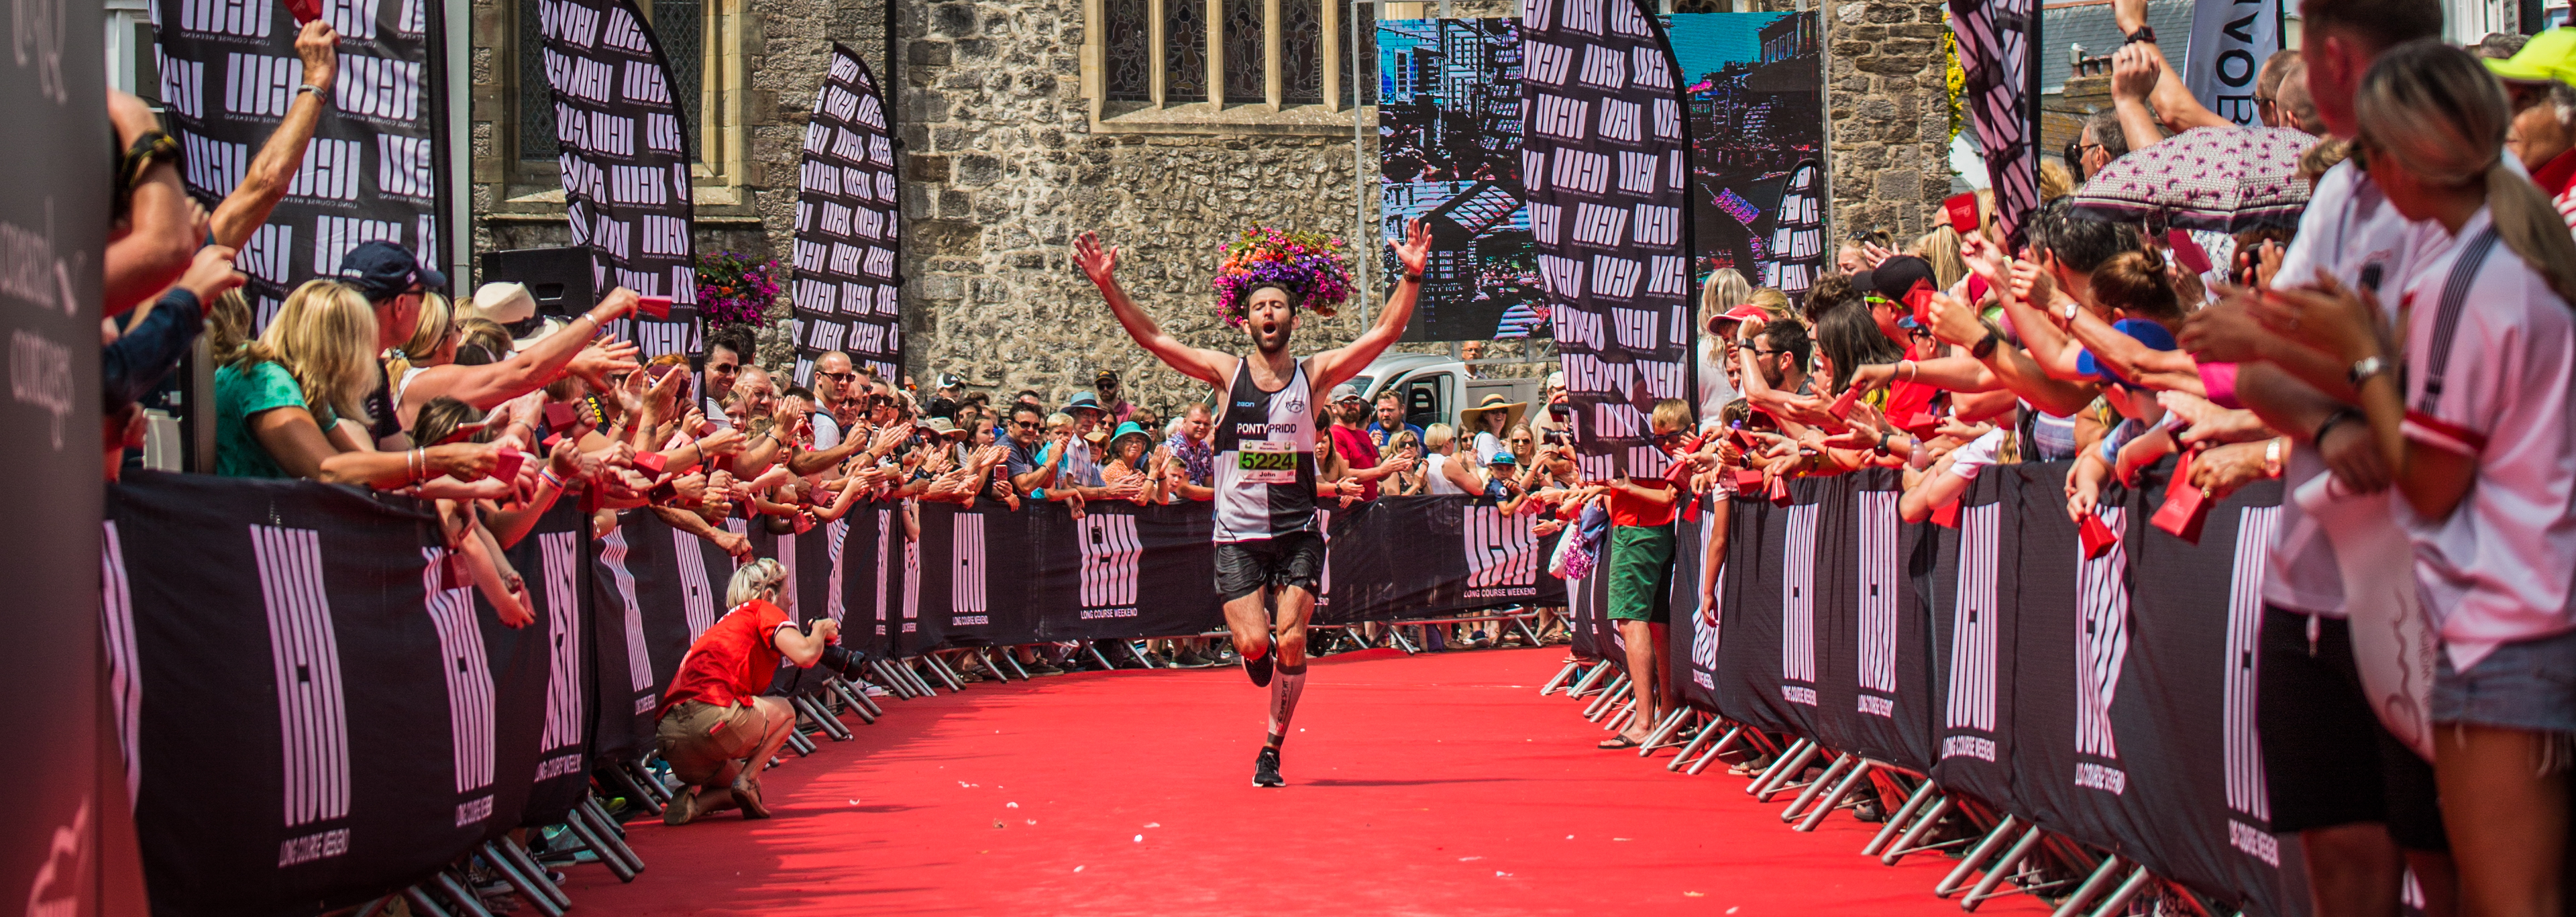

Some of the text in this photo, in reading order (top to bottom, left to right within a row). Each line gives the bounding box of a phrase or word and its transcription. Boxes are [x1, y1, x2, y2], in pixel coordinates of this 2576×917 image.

[1236, 423, 1297, 434] PONTYPRIDD
[1241, 451, 1294, 470] 5224
[1464, 587, 1536, 598] LONG COURSE WEEKEND
[1081, 607, 1138, 619] LONG COURSE WEEKEND
[1942, 735, 1996, 763] LONG COURSE WEEKEND
